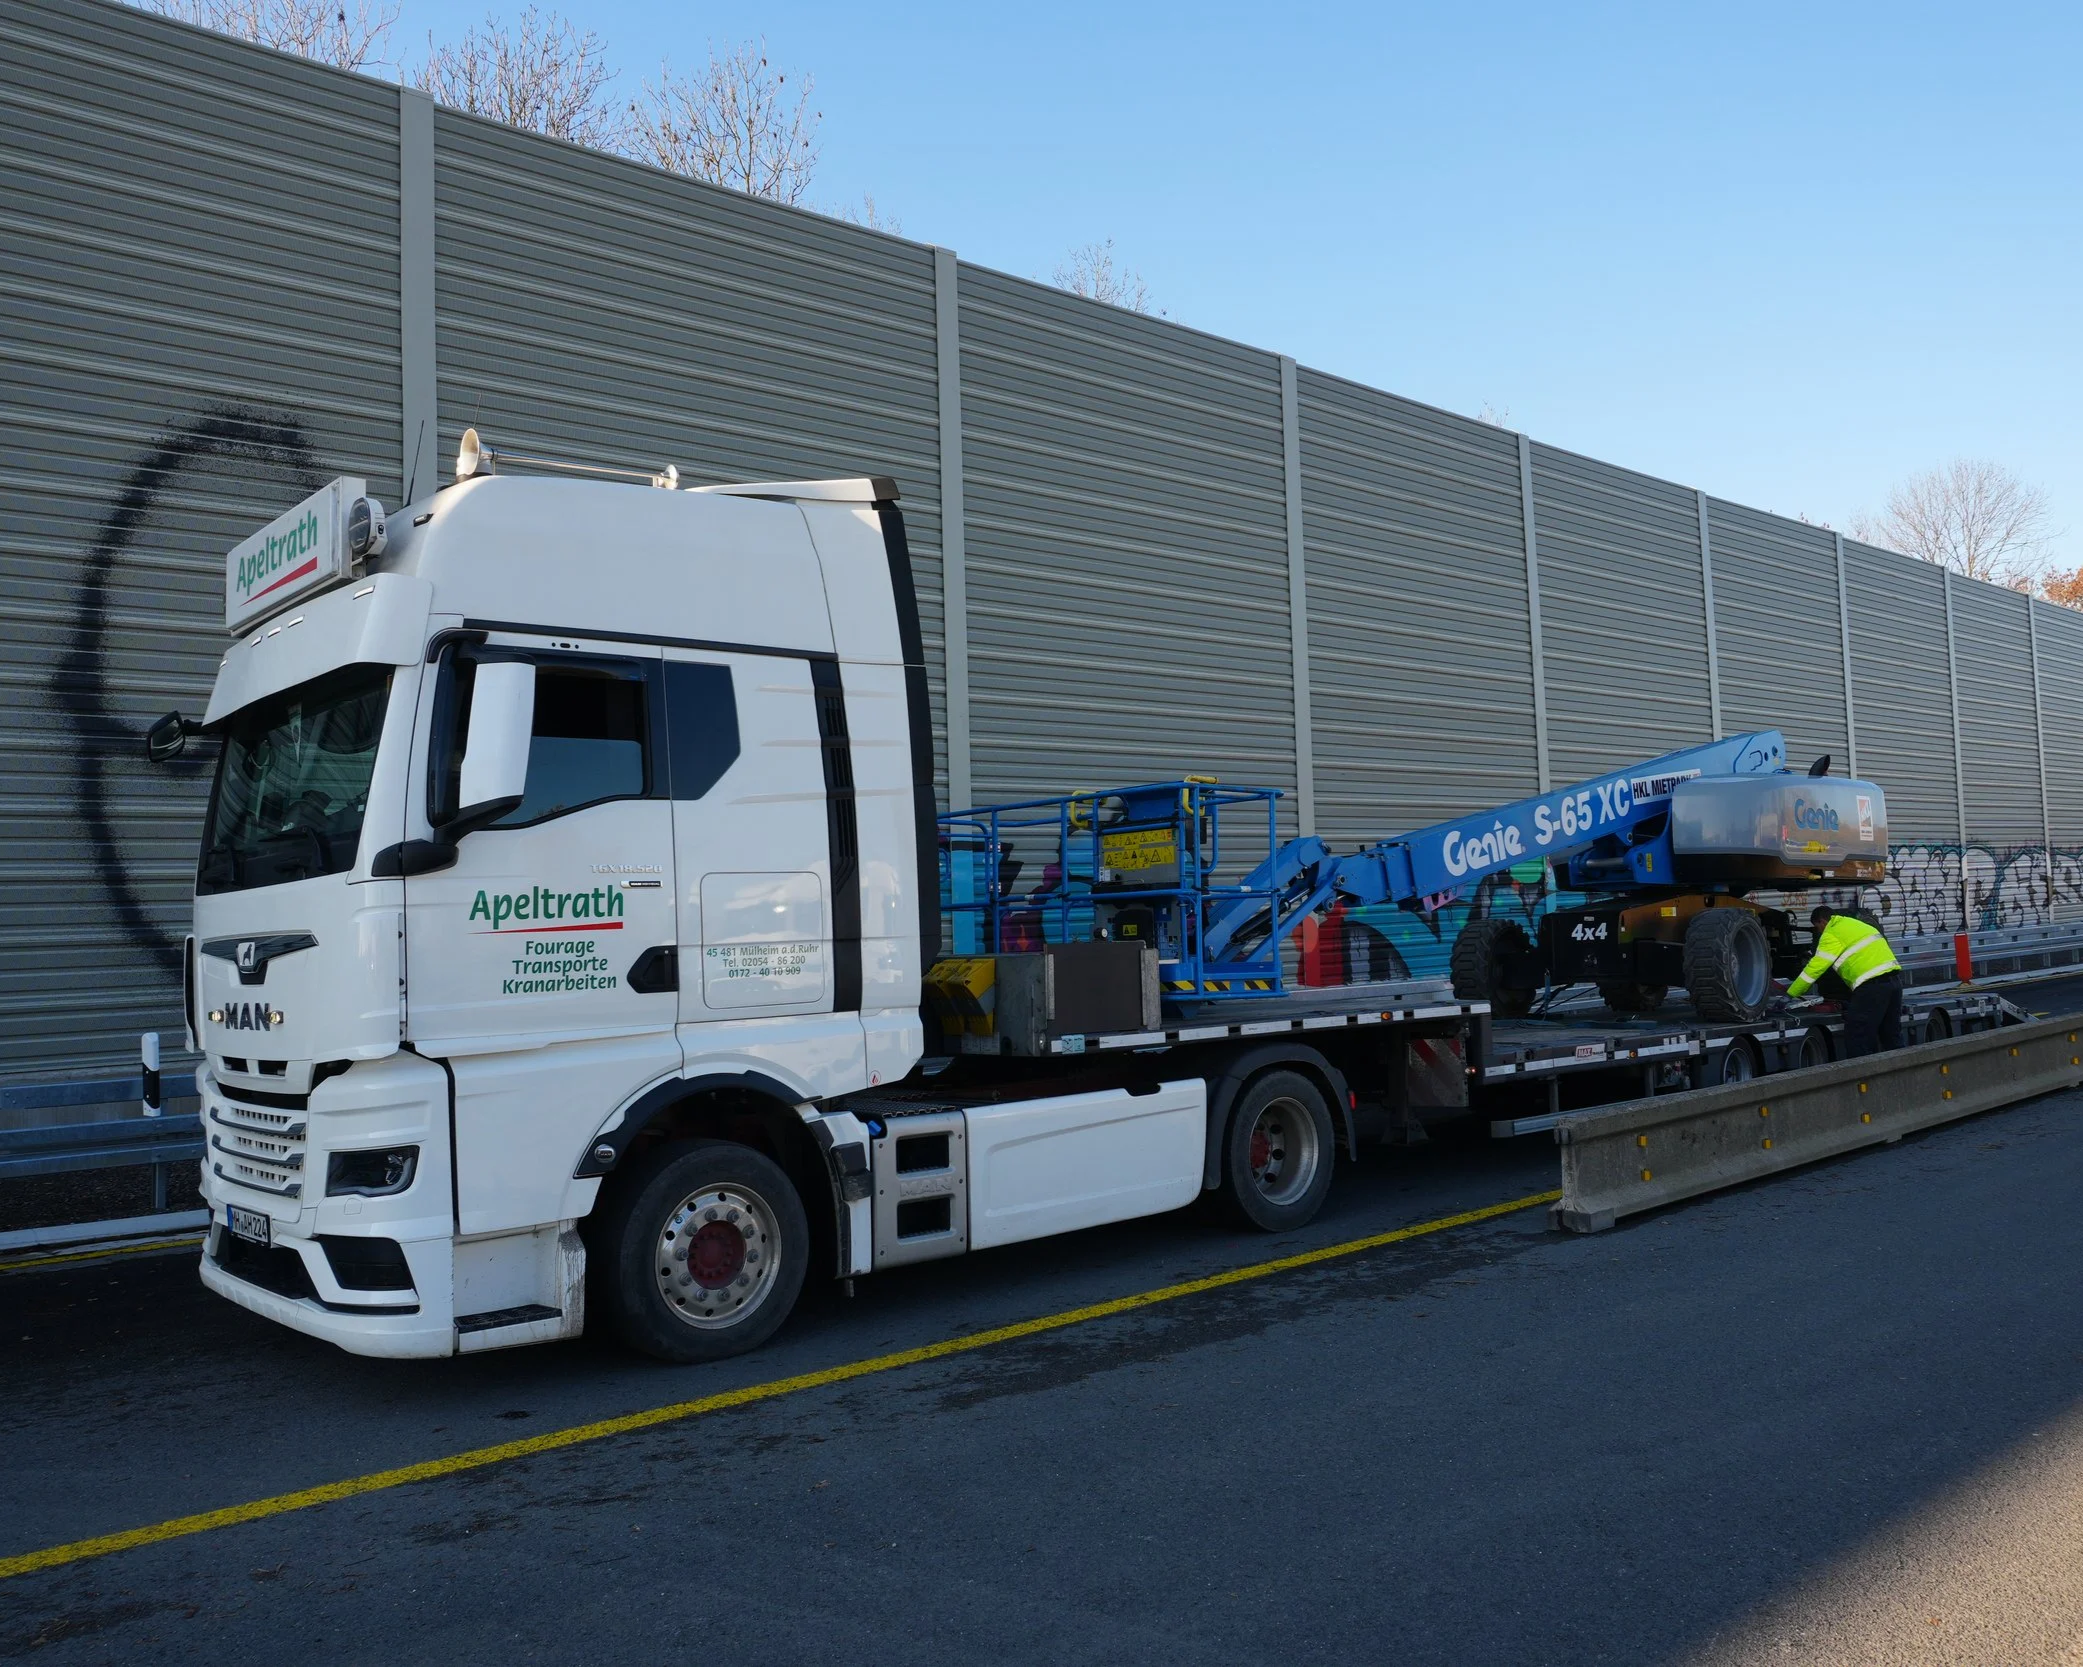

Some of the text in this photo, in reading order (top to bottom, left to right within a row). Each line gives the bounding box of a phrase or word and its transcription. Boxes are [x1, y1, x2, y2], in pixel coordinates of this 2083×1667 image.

[236, 509, 318, 597] Apeltrath
[1632, 781, 1650, 799] HKL
[1794, 798, 1839, 832] Genie
[1443, 778, 1630, 876] Genie S-65 XC
[591, 864, 662, 873] TGX 18.520
[469, 885, 624, 930] Apeltrath
[1571, 922, 1608, 941] 4x4
[525, 940, 595, 957] Fourage
[706, 948, 718, 957] 45
[720, 947, 736, 957] 481
[739, 945, 779, 956] Mülheim
[512, 956, 608, 976] Transporte
[722, 958, 739, 968] Tel.
[741, 957, 769, 967] 02054
[777, 956, 788, 965] 86
[790, 955, 806, 965] 200
[728, 968, 750, 978] 0172
[759, 967, 770, 977] 40
[785, 966, 801, 975] 909
[503, 974, 617, 994] Kranarbeiten
[225, 1003, 270, 1031] MAN
